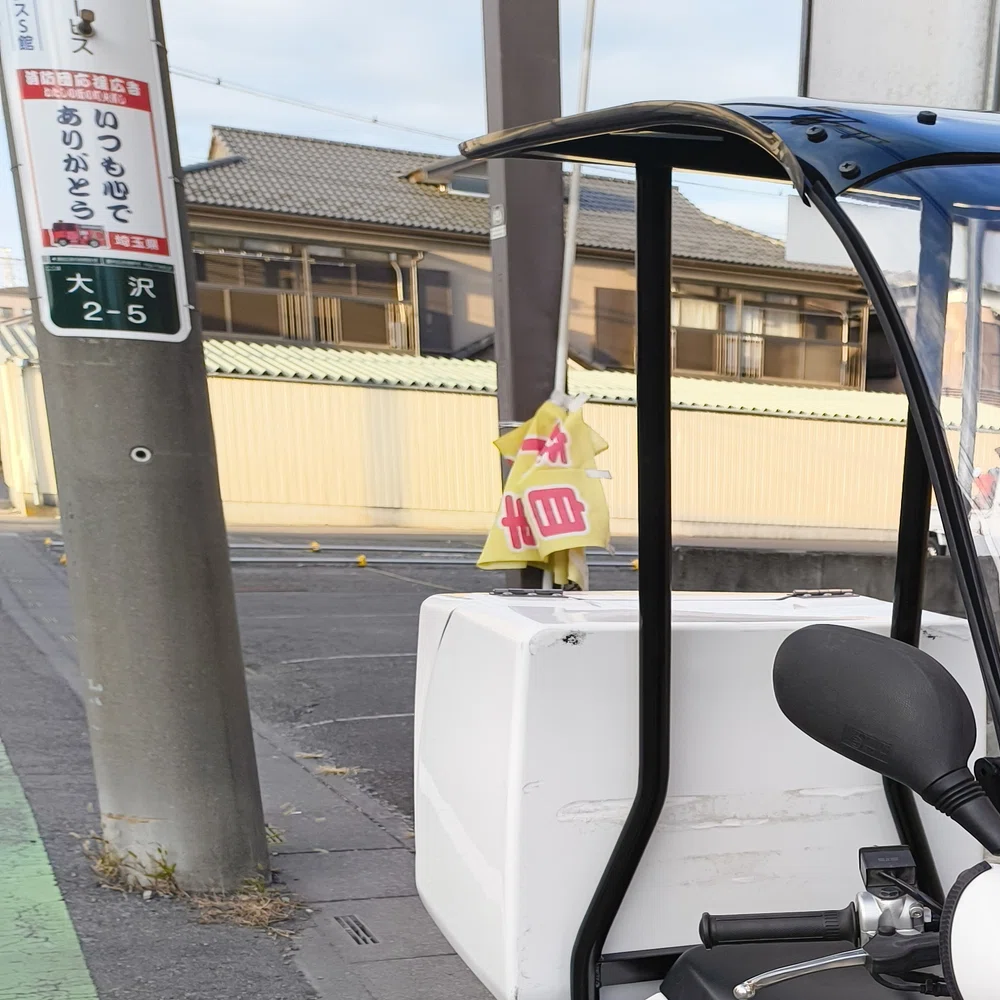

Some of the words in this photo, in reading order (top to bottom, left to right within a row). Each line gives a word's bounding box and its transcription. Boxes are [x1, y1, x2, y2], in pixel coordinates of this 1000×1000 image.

[13, 0, 34, 51] スS館
[57, 105, 95, 220] ありがとう
[94, 108, 133, 223] いつも心で
[115, 234, 159, 250] 埼玉県
[65, 272, 157, 299] 大沢
[82, 301, 147, 324] 2-5
